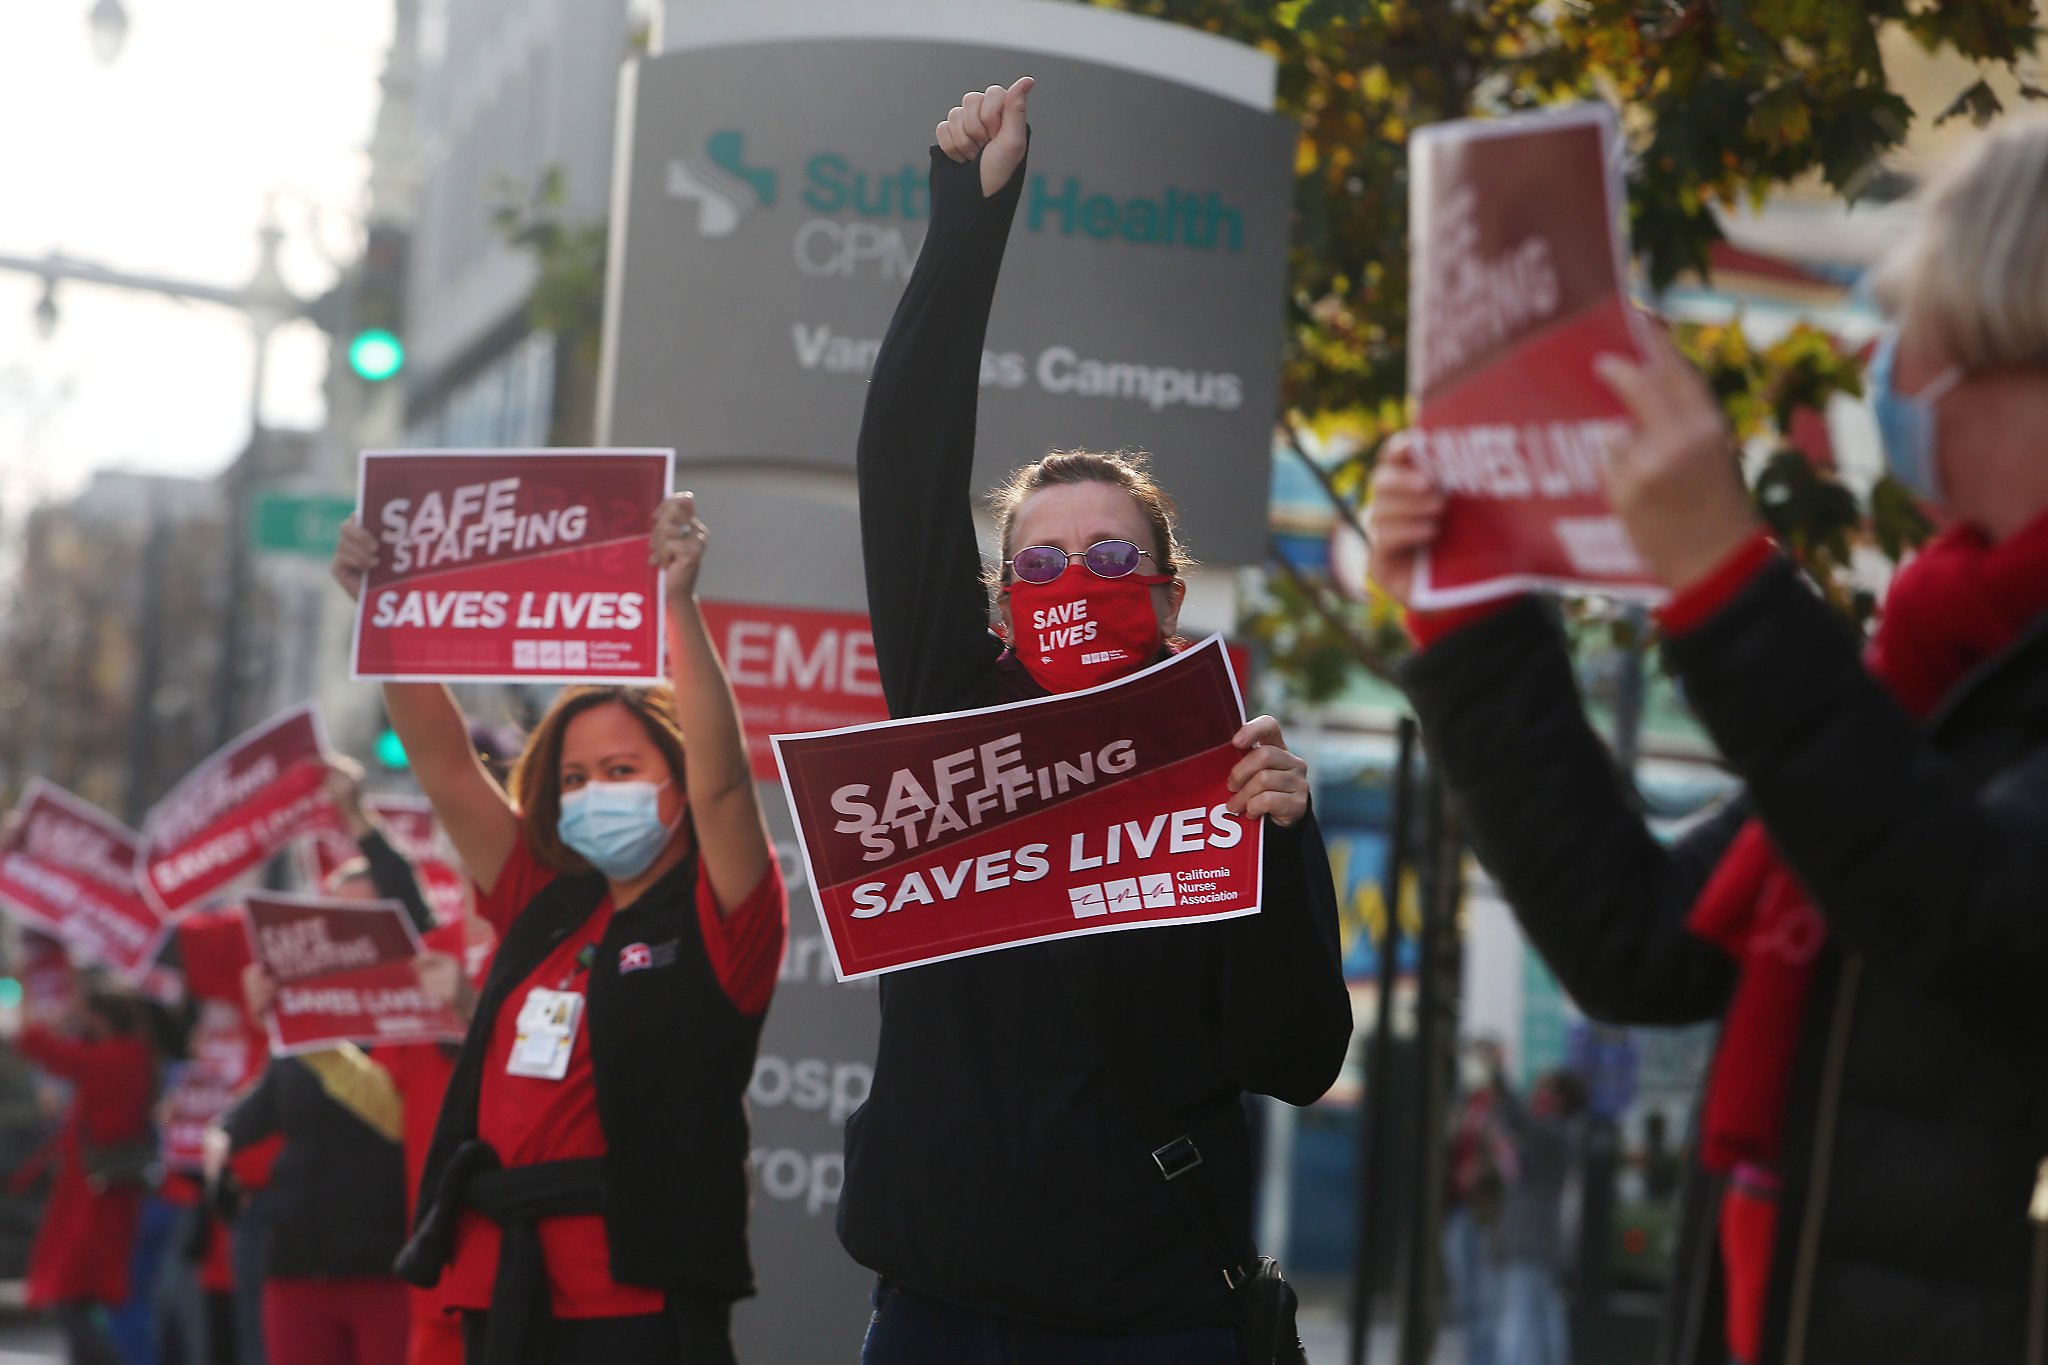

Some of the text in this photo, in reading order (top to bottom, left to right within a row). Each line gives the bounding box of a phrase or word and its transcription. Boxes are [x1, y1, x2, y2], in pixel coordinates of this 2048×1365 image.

[803, 151, 1245, 254] Sut Health
[794, 219, 919, 281] CPM
[978, 349, 1025, 389] ss
[1037, 345, 1242, 411] Campus
[380, 477, 520, 547] SAFE
[392, 505, 588, 573] STAFFING
[371, 590, 644, 630] SAVES LIVES
[1033, 599, 1088, 630] SAVE
[1038, 621, 1098, 652] LIVES
[726, 620, 882, 697] EME
[830, 732, 1032, 834] SAFE
[859, 739, 1137, 862] STAFFING
[850, 843, 1051, 920] SAVES
[1069, 802, 1243, 873] LIVES
[1176, 866, 1231, 882] California
[1178, 881, 1217, 894] Nurses
[1180, 890, 1238, 906] Association
